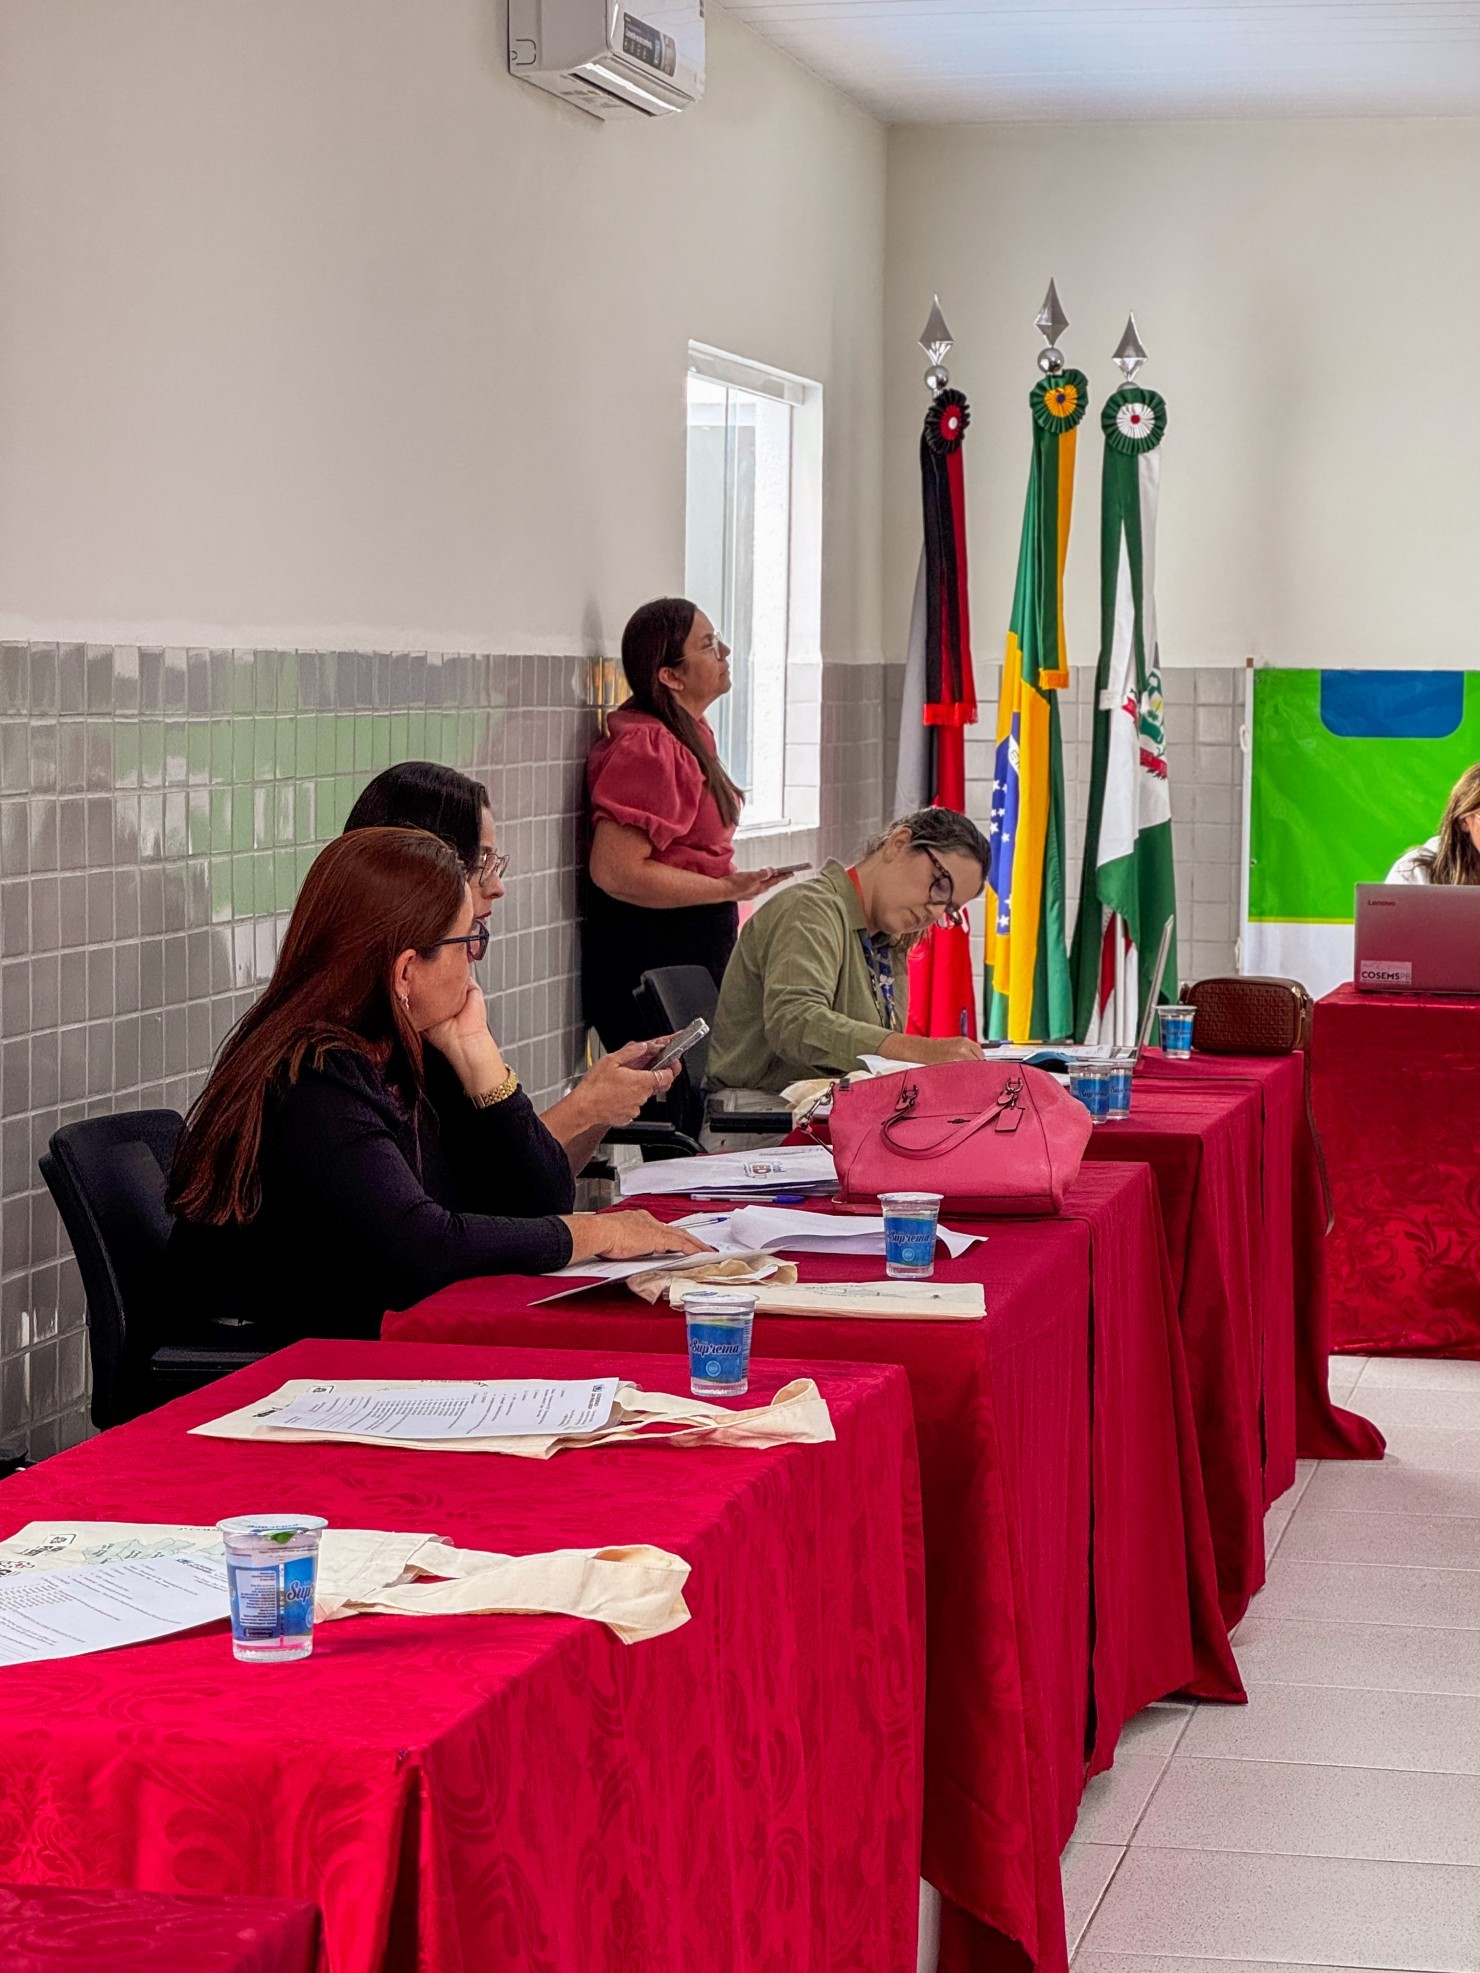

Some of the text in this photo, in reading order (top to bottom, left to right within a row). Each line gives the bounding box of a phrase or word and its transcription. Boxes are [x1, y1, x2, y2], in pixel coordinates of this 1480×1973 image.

[1361, 971, 1400, 980] COSEMS
[889, 1231, 930, 1246] Suprema
[692, 1338, 740, 1357] Suprema
